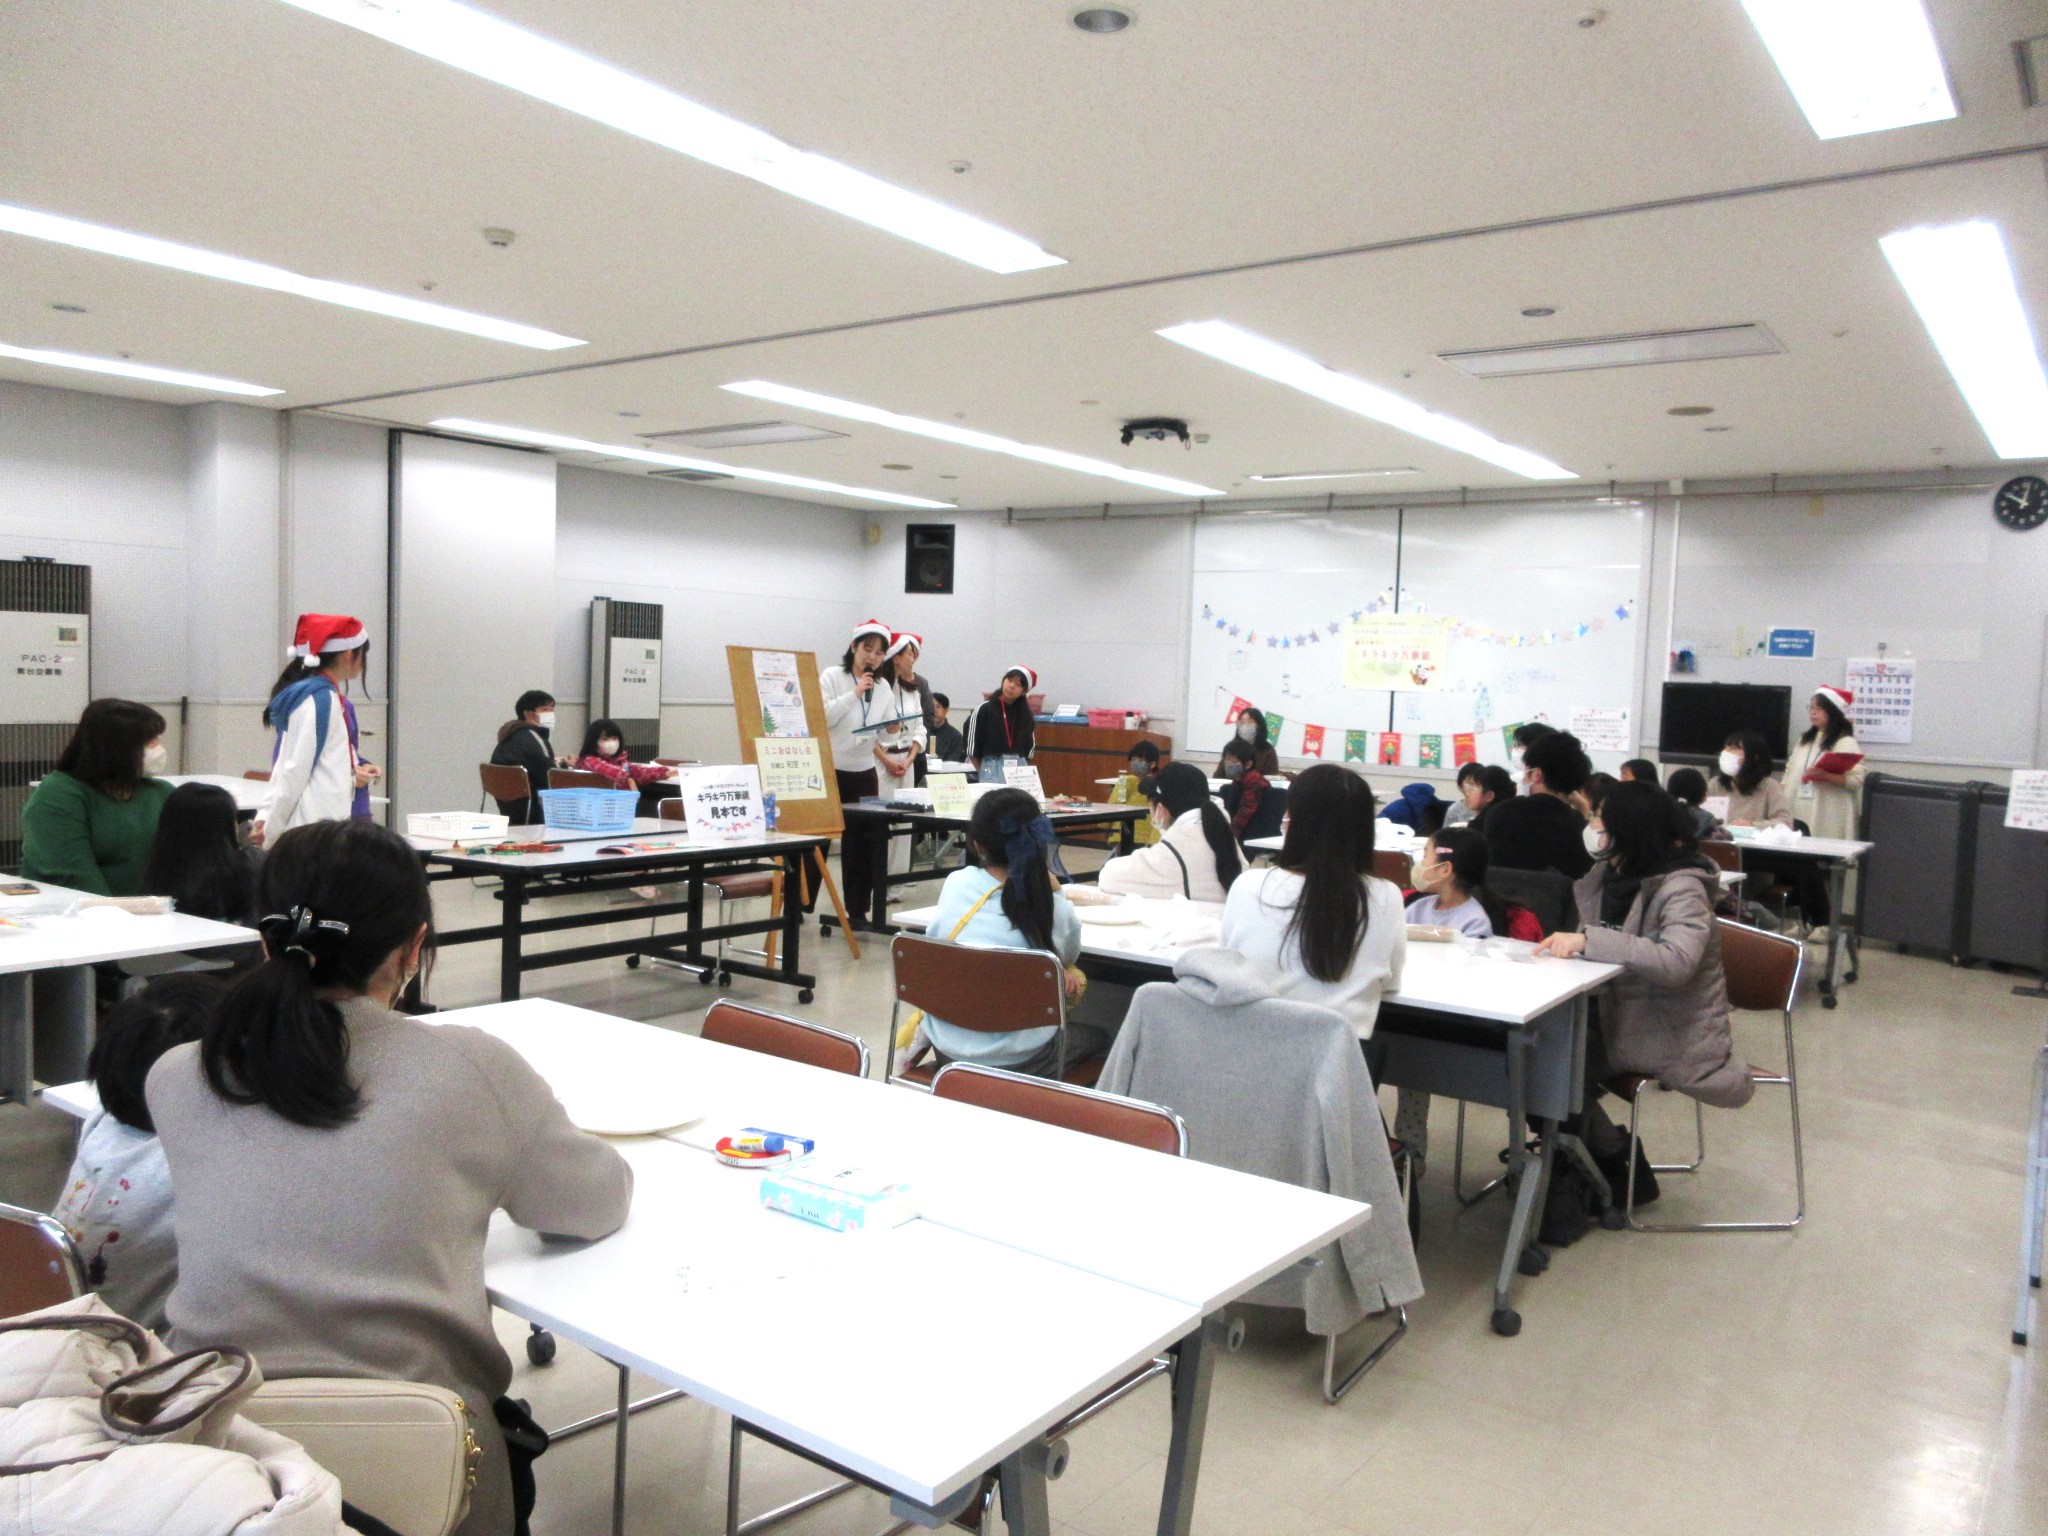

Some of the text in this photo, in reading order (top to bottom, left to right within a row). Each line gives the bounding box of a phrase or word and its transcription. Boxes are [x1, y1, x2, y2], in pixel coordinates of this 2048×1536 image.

[21, 654, 62, 663] PAC-2
[764, 745, 812, 756] ミニおはなし会
[697, 790, 750, 803] キラキラ万華鏡
[711, 805, 747, 819] 見本です
